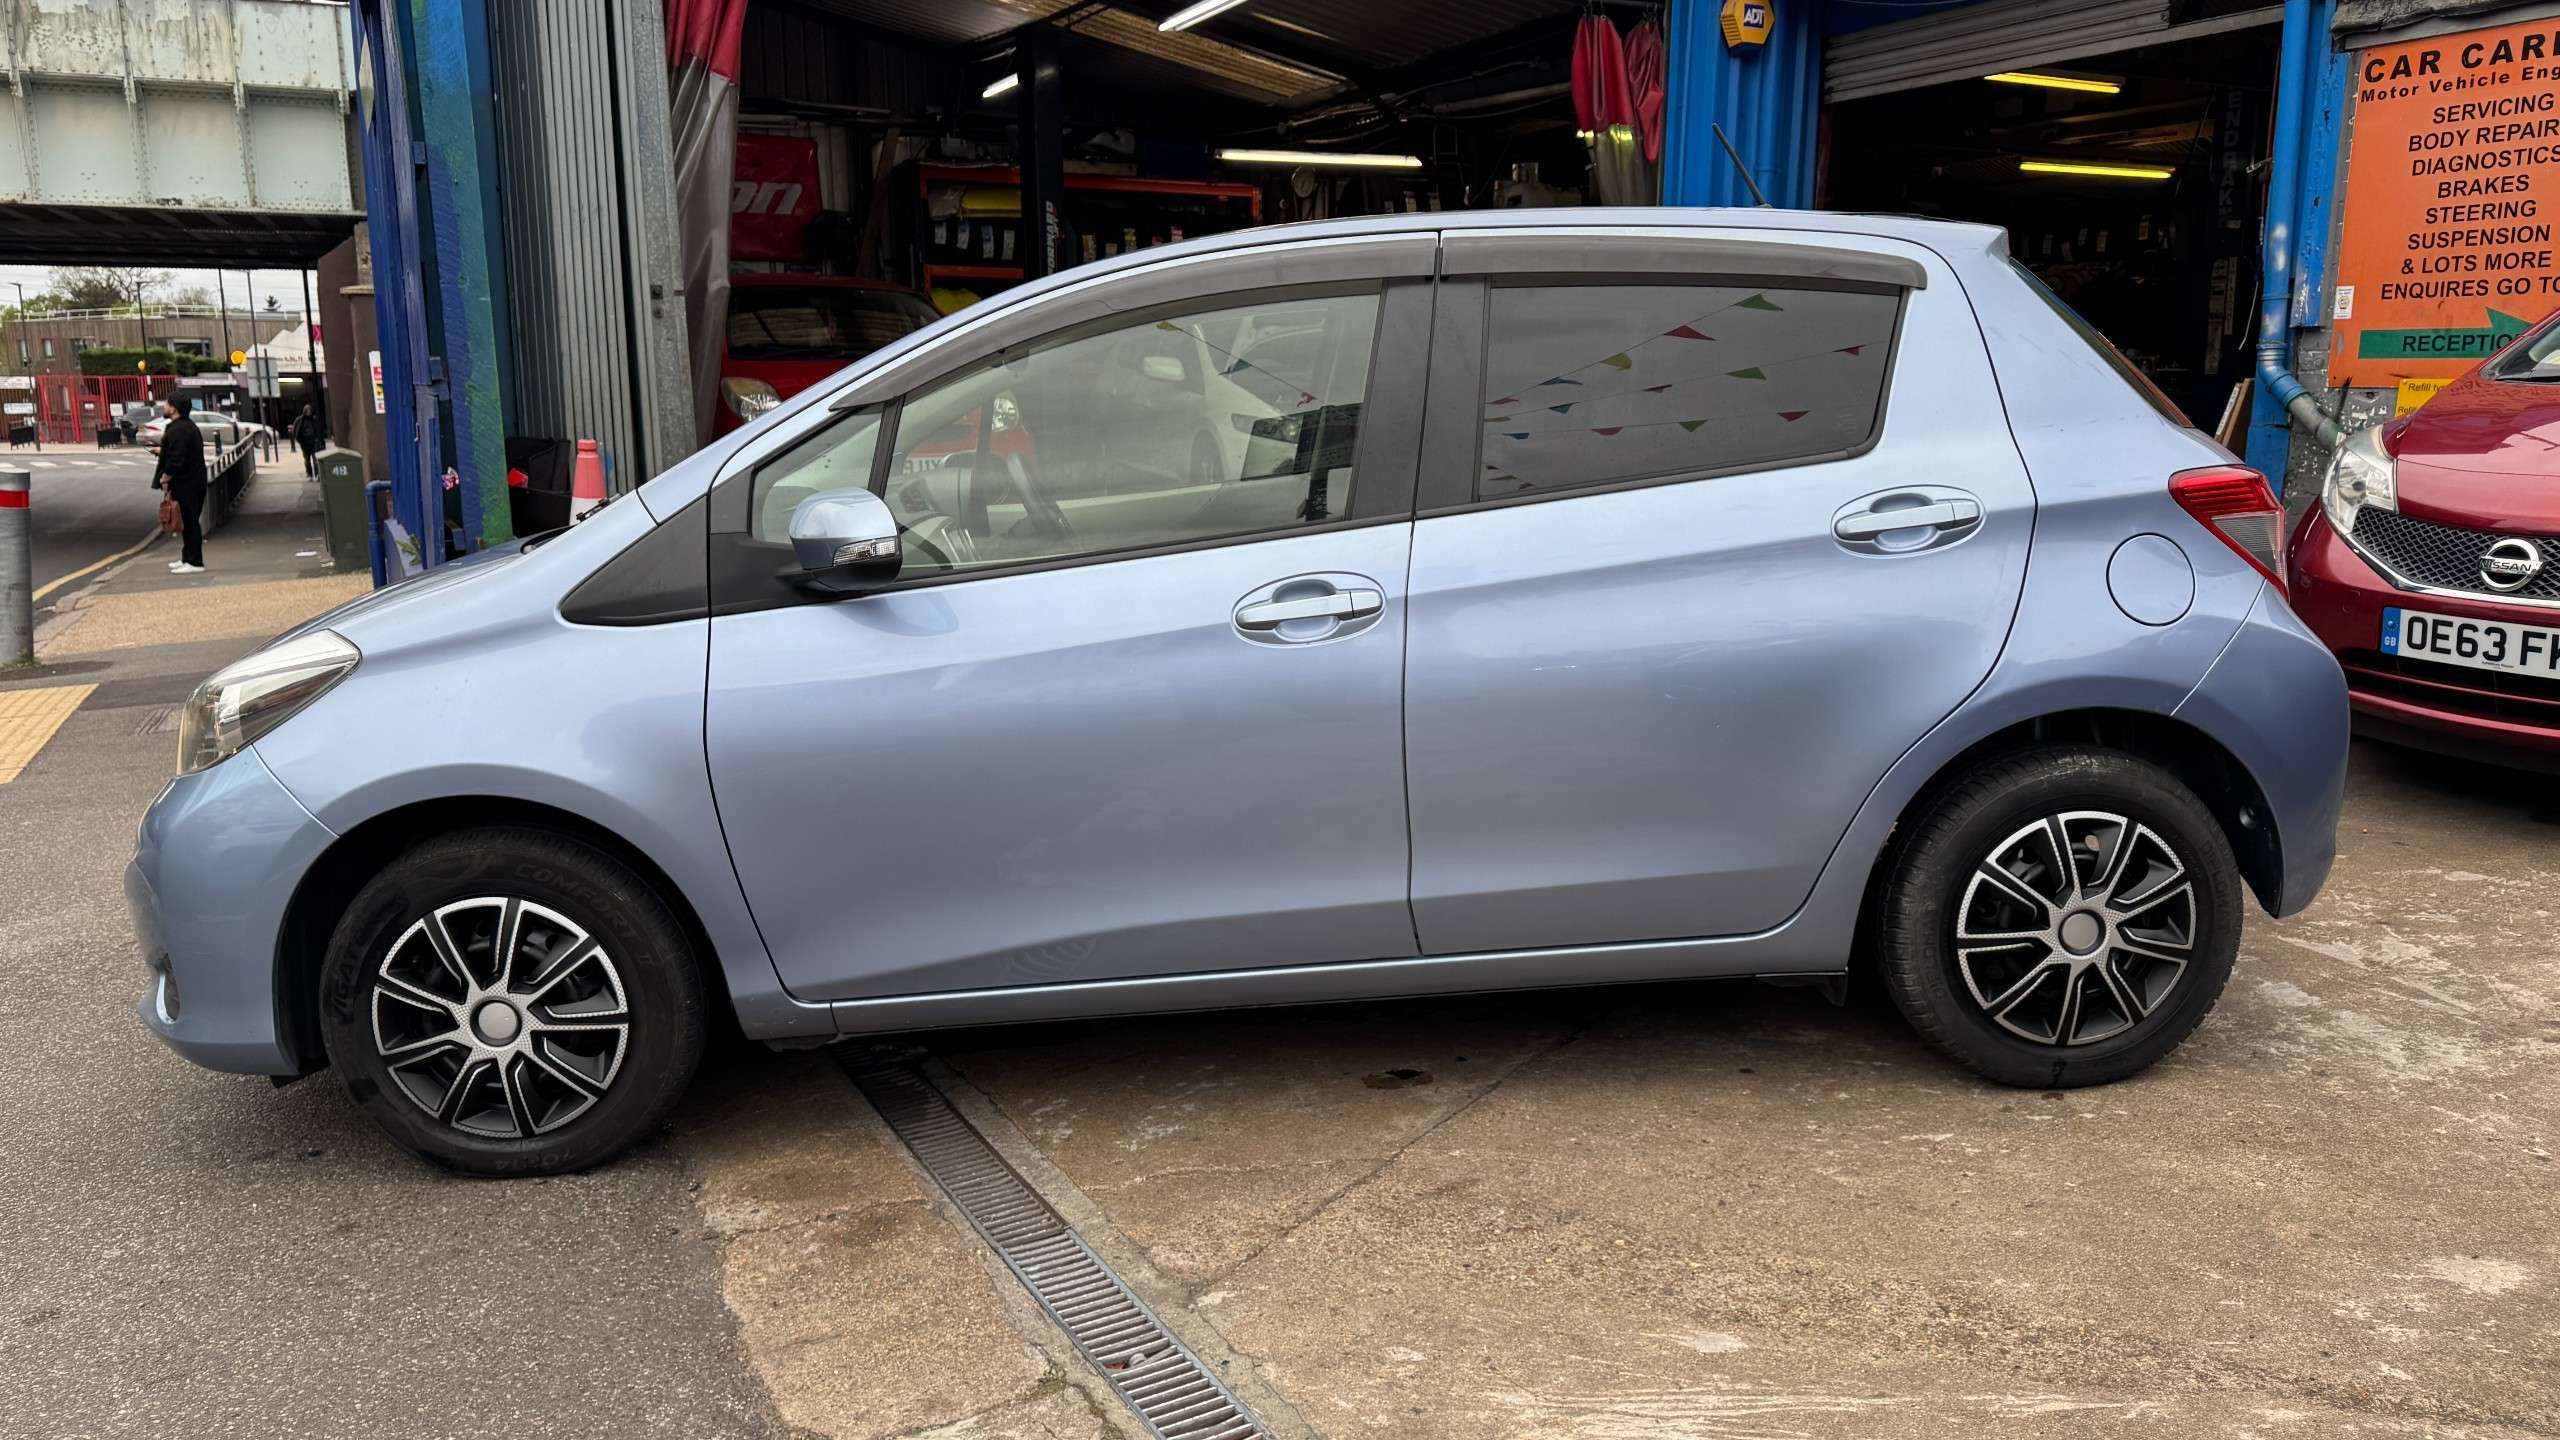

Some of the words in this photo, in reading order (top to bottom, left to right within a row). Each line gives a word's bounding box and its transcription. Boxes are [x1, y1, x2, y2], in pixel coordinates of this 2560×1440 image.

[1744, 8, 1765, 25] ADT
[2364, 50, 2441, 83] CAR
[2361, 84, 2419, 103] Motor
[2429, 71, 2510, 93] Vehicle
[2432, 92, 2554, 124] SERVICING
[2408, 129, 2470, 152] BODY
[2475, 118, 2560, 145] REPAIR
[2412, 144, 2560, 176] DIAGNOSTICS
[2437, 174, 2530, 199] BRAKES
[2425, 200, 2537, 224] STEERING
[2407, 224, 2551, 250] SUSPENSION
[2401, 258, 2414, 275] &
[2421, 254, 2478, 274] LOTS
[2484, 250, 2553, 271] MORE
[2380, 279, 2489, 300] ENQUIRES
[2496, 277, 2531, 295] GO
[2402, 333, 2518, 352] RECEPTIO
[2480, 557, 2532, 572] NISSAN
[2384, 636, 2397, 647] GB
[2406, 616, 2507, 662] OE63
